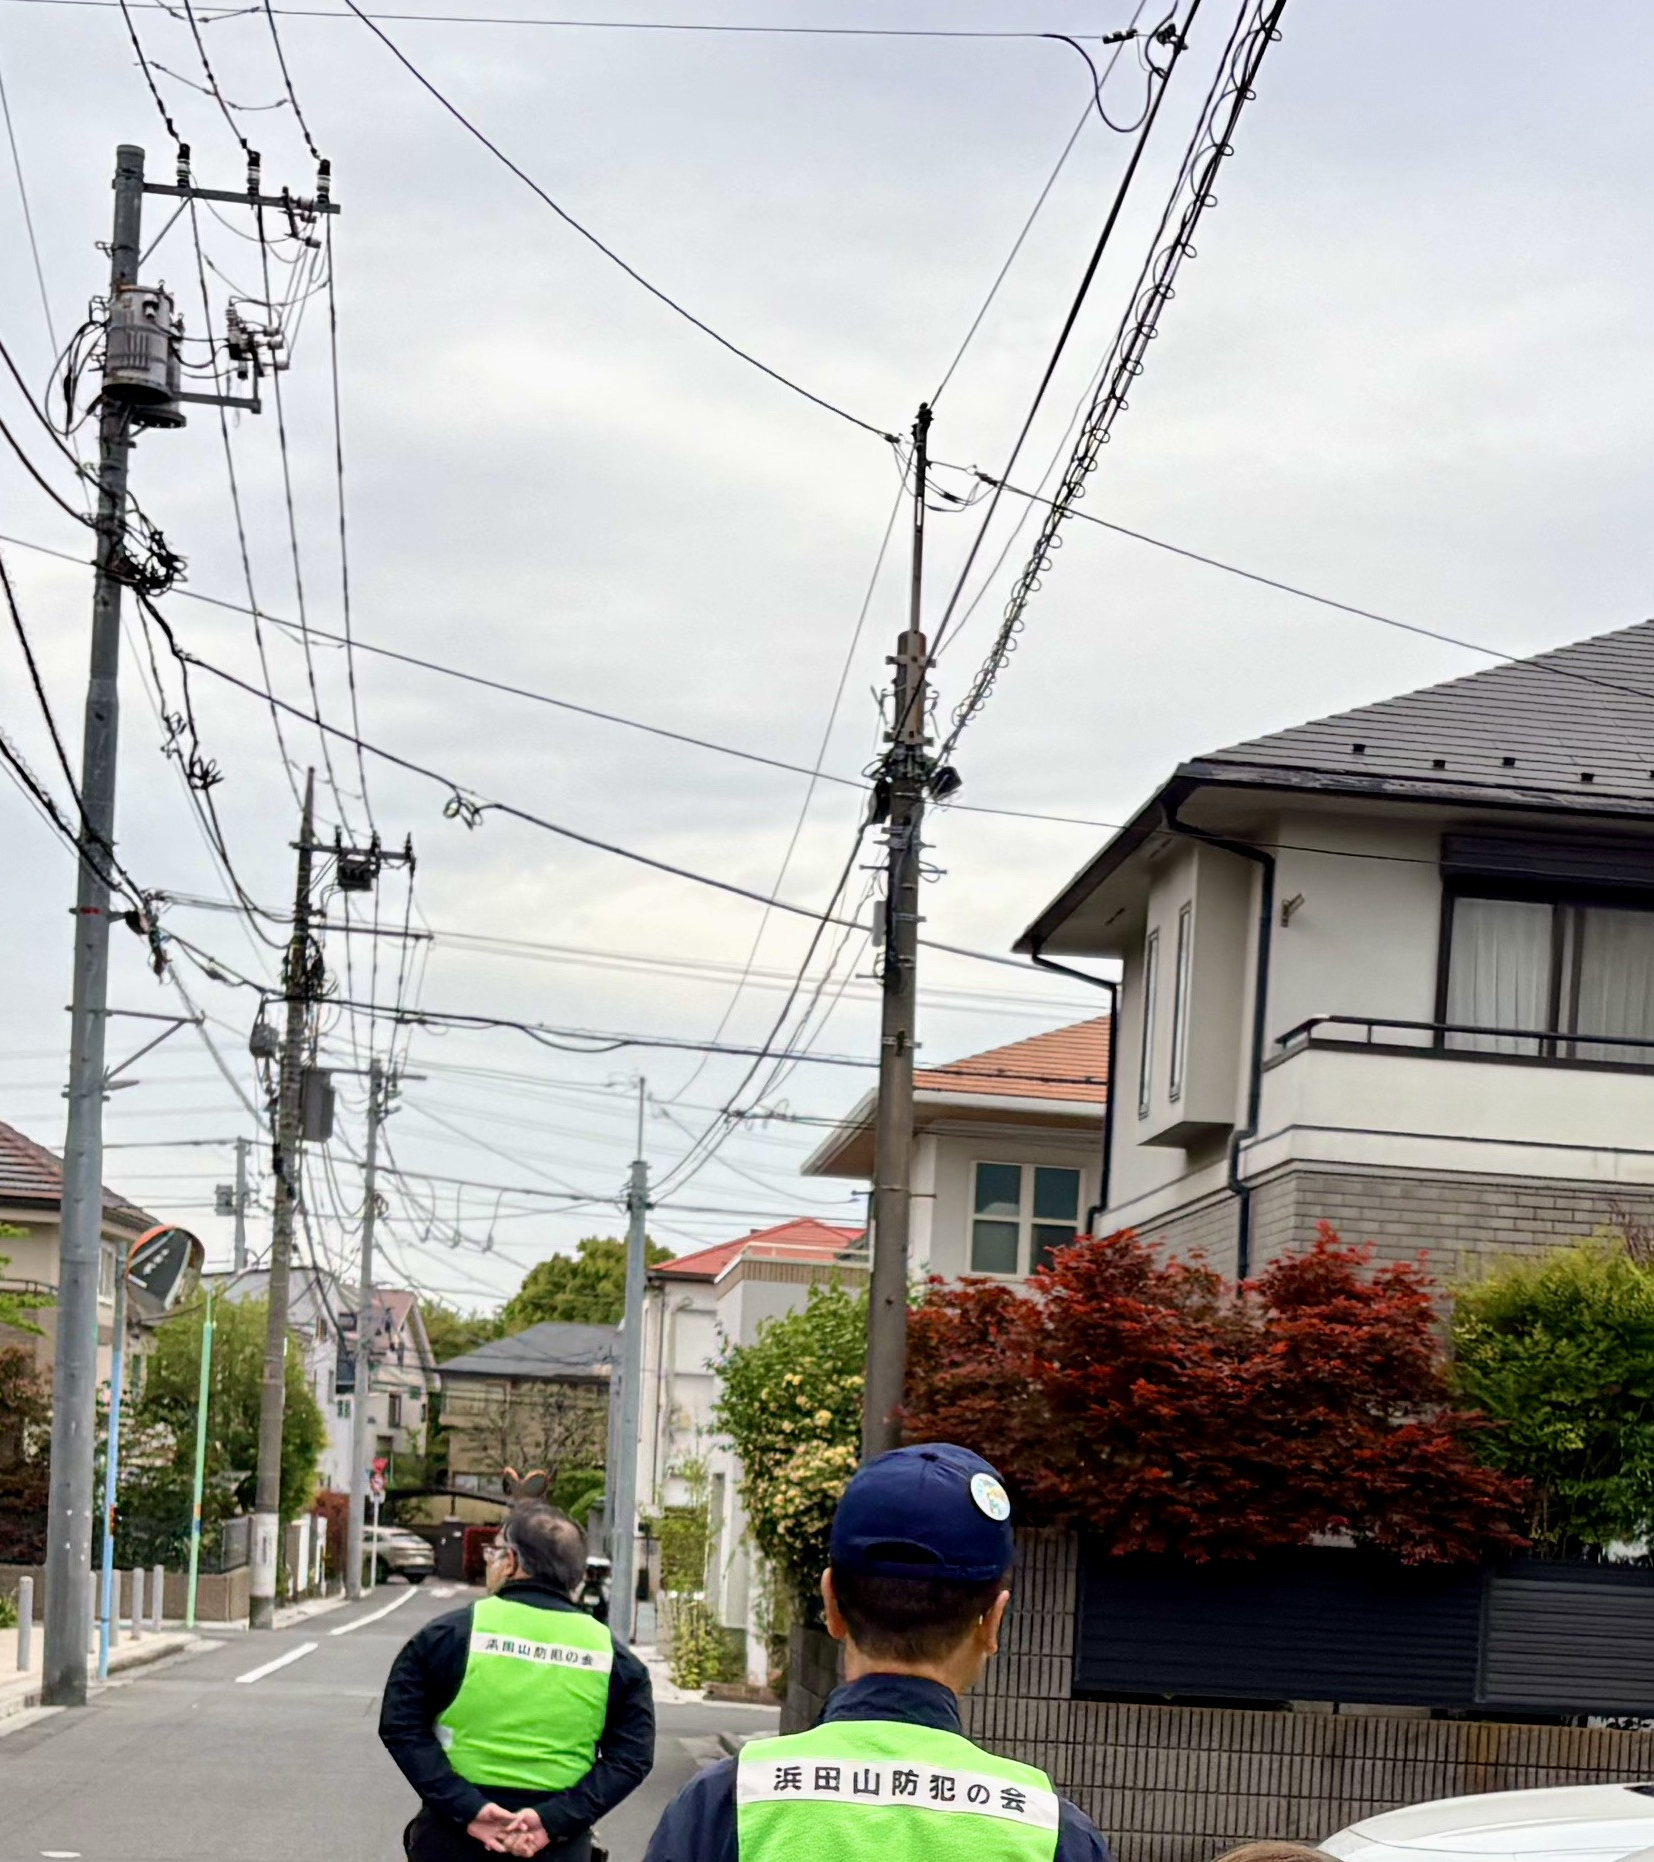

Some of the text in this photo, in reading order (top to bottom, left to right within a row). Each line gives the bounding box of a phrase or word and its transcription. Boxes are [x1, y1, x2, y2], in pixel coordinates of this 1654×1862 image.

[484, 1637, 596, 1666] 浜田山防犯の会
[771, 1764, 1029, 1814] 浜田山防犯の会
